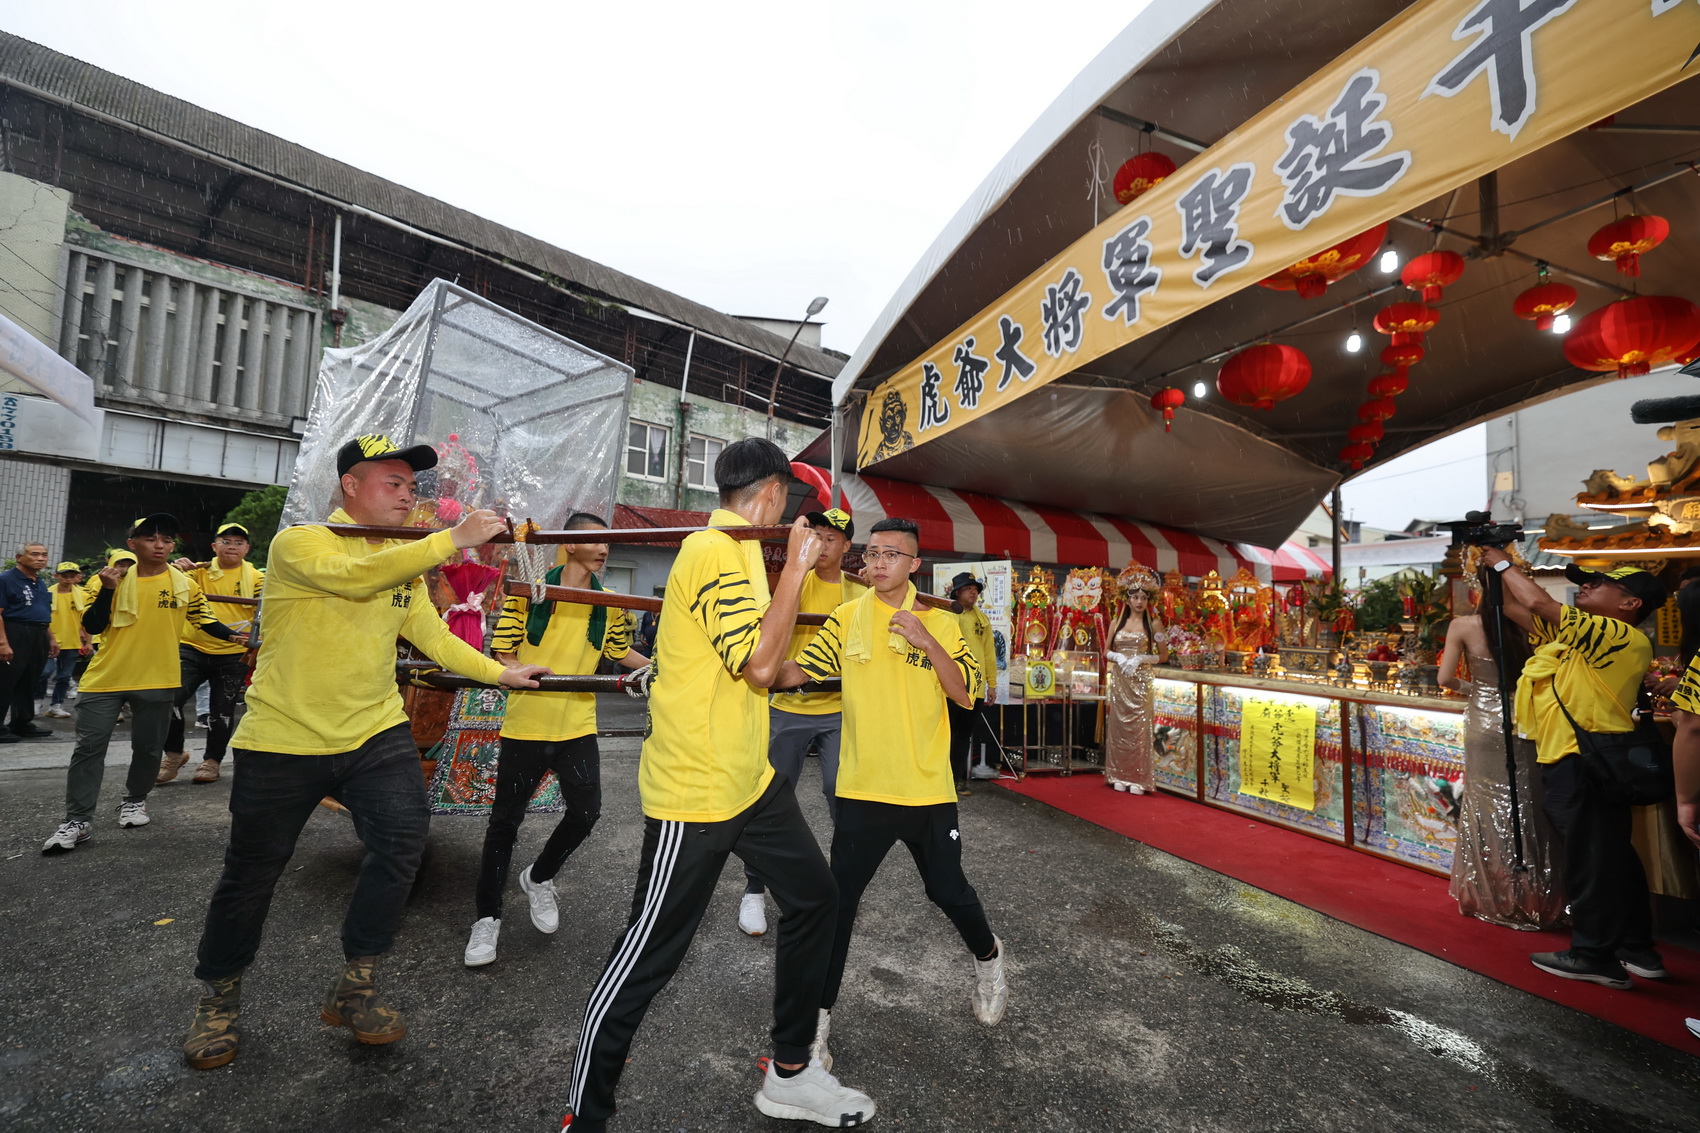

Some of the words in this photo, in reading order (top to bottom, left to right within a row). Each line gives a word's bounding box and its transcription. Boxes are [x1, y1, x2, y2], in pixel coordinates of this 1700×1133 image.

[918, 0, 1700, 434] 虎爺大將軍聖誕千
[905, 652, 932, 671] 虎爺
